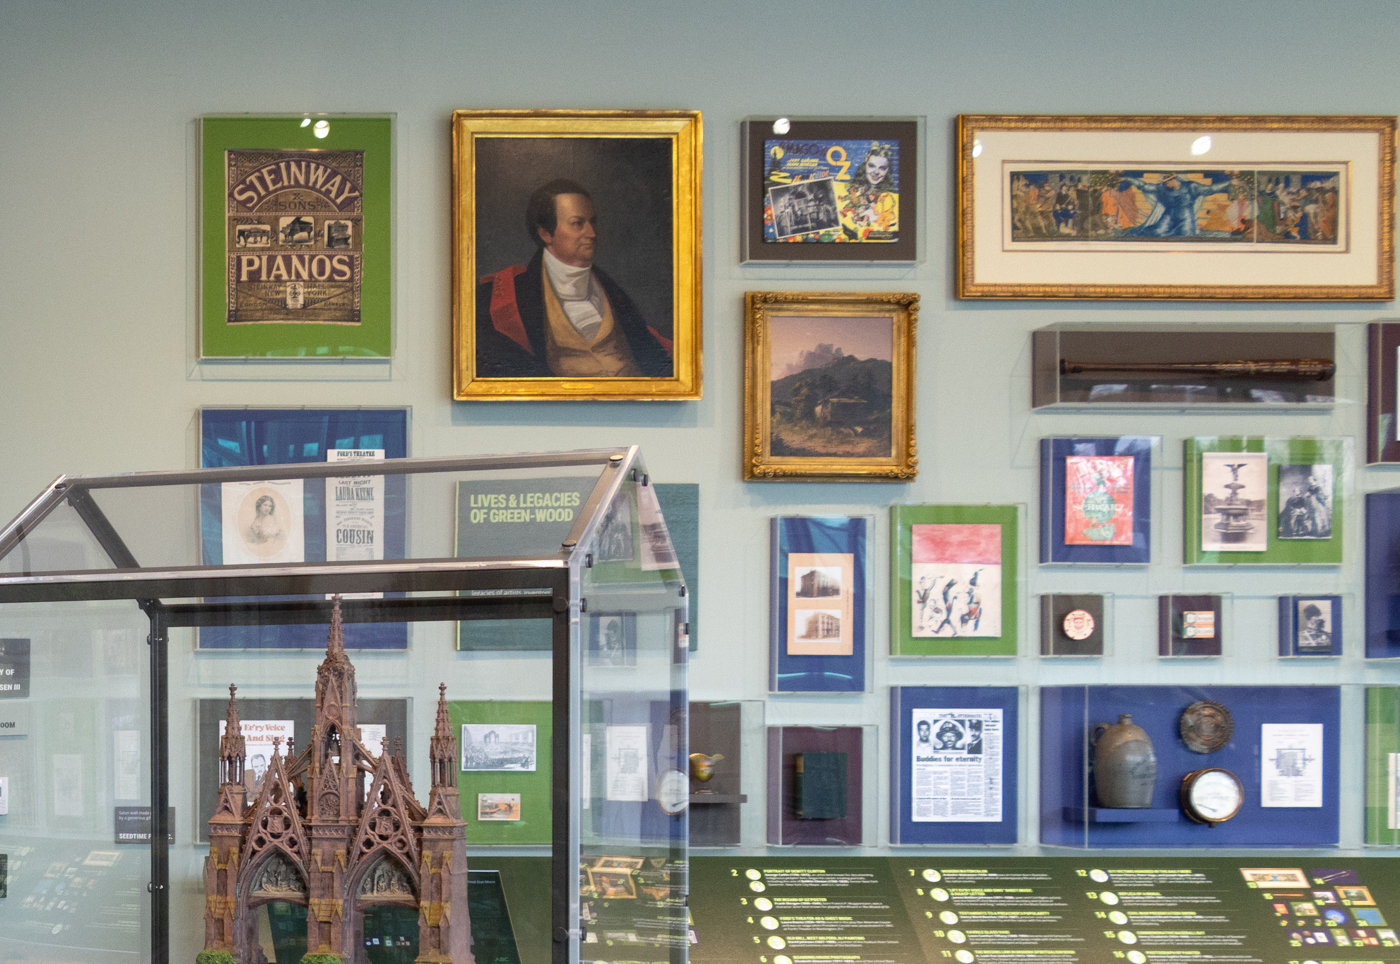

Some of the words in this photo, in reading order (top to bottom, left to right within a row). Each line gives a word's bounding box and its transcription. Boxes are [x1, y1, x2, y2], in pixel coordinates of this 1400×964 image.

[234, 161, 360, 207] STEINWAY
[278, 201, 316, 210] SONS
[240, 255, 351, 281] PIANOS
[336, 486, 354, 500] LAURA
[356, 487, 374, 500] KEENE
[470, 494, 506, 508] LIVES
[508, 494, 518, 507] &
[520, 492, 580, 506] LEGACIES
[470, 510, 488, 522] OF
[490, 508, 574, 522] GREEN-WOOD
[336, 529, 374, 544] COUSIN
[244, 724, 266, 733] Ev'ry
[266, 724, 286, 732] Voice
